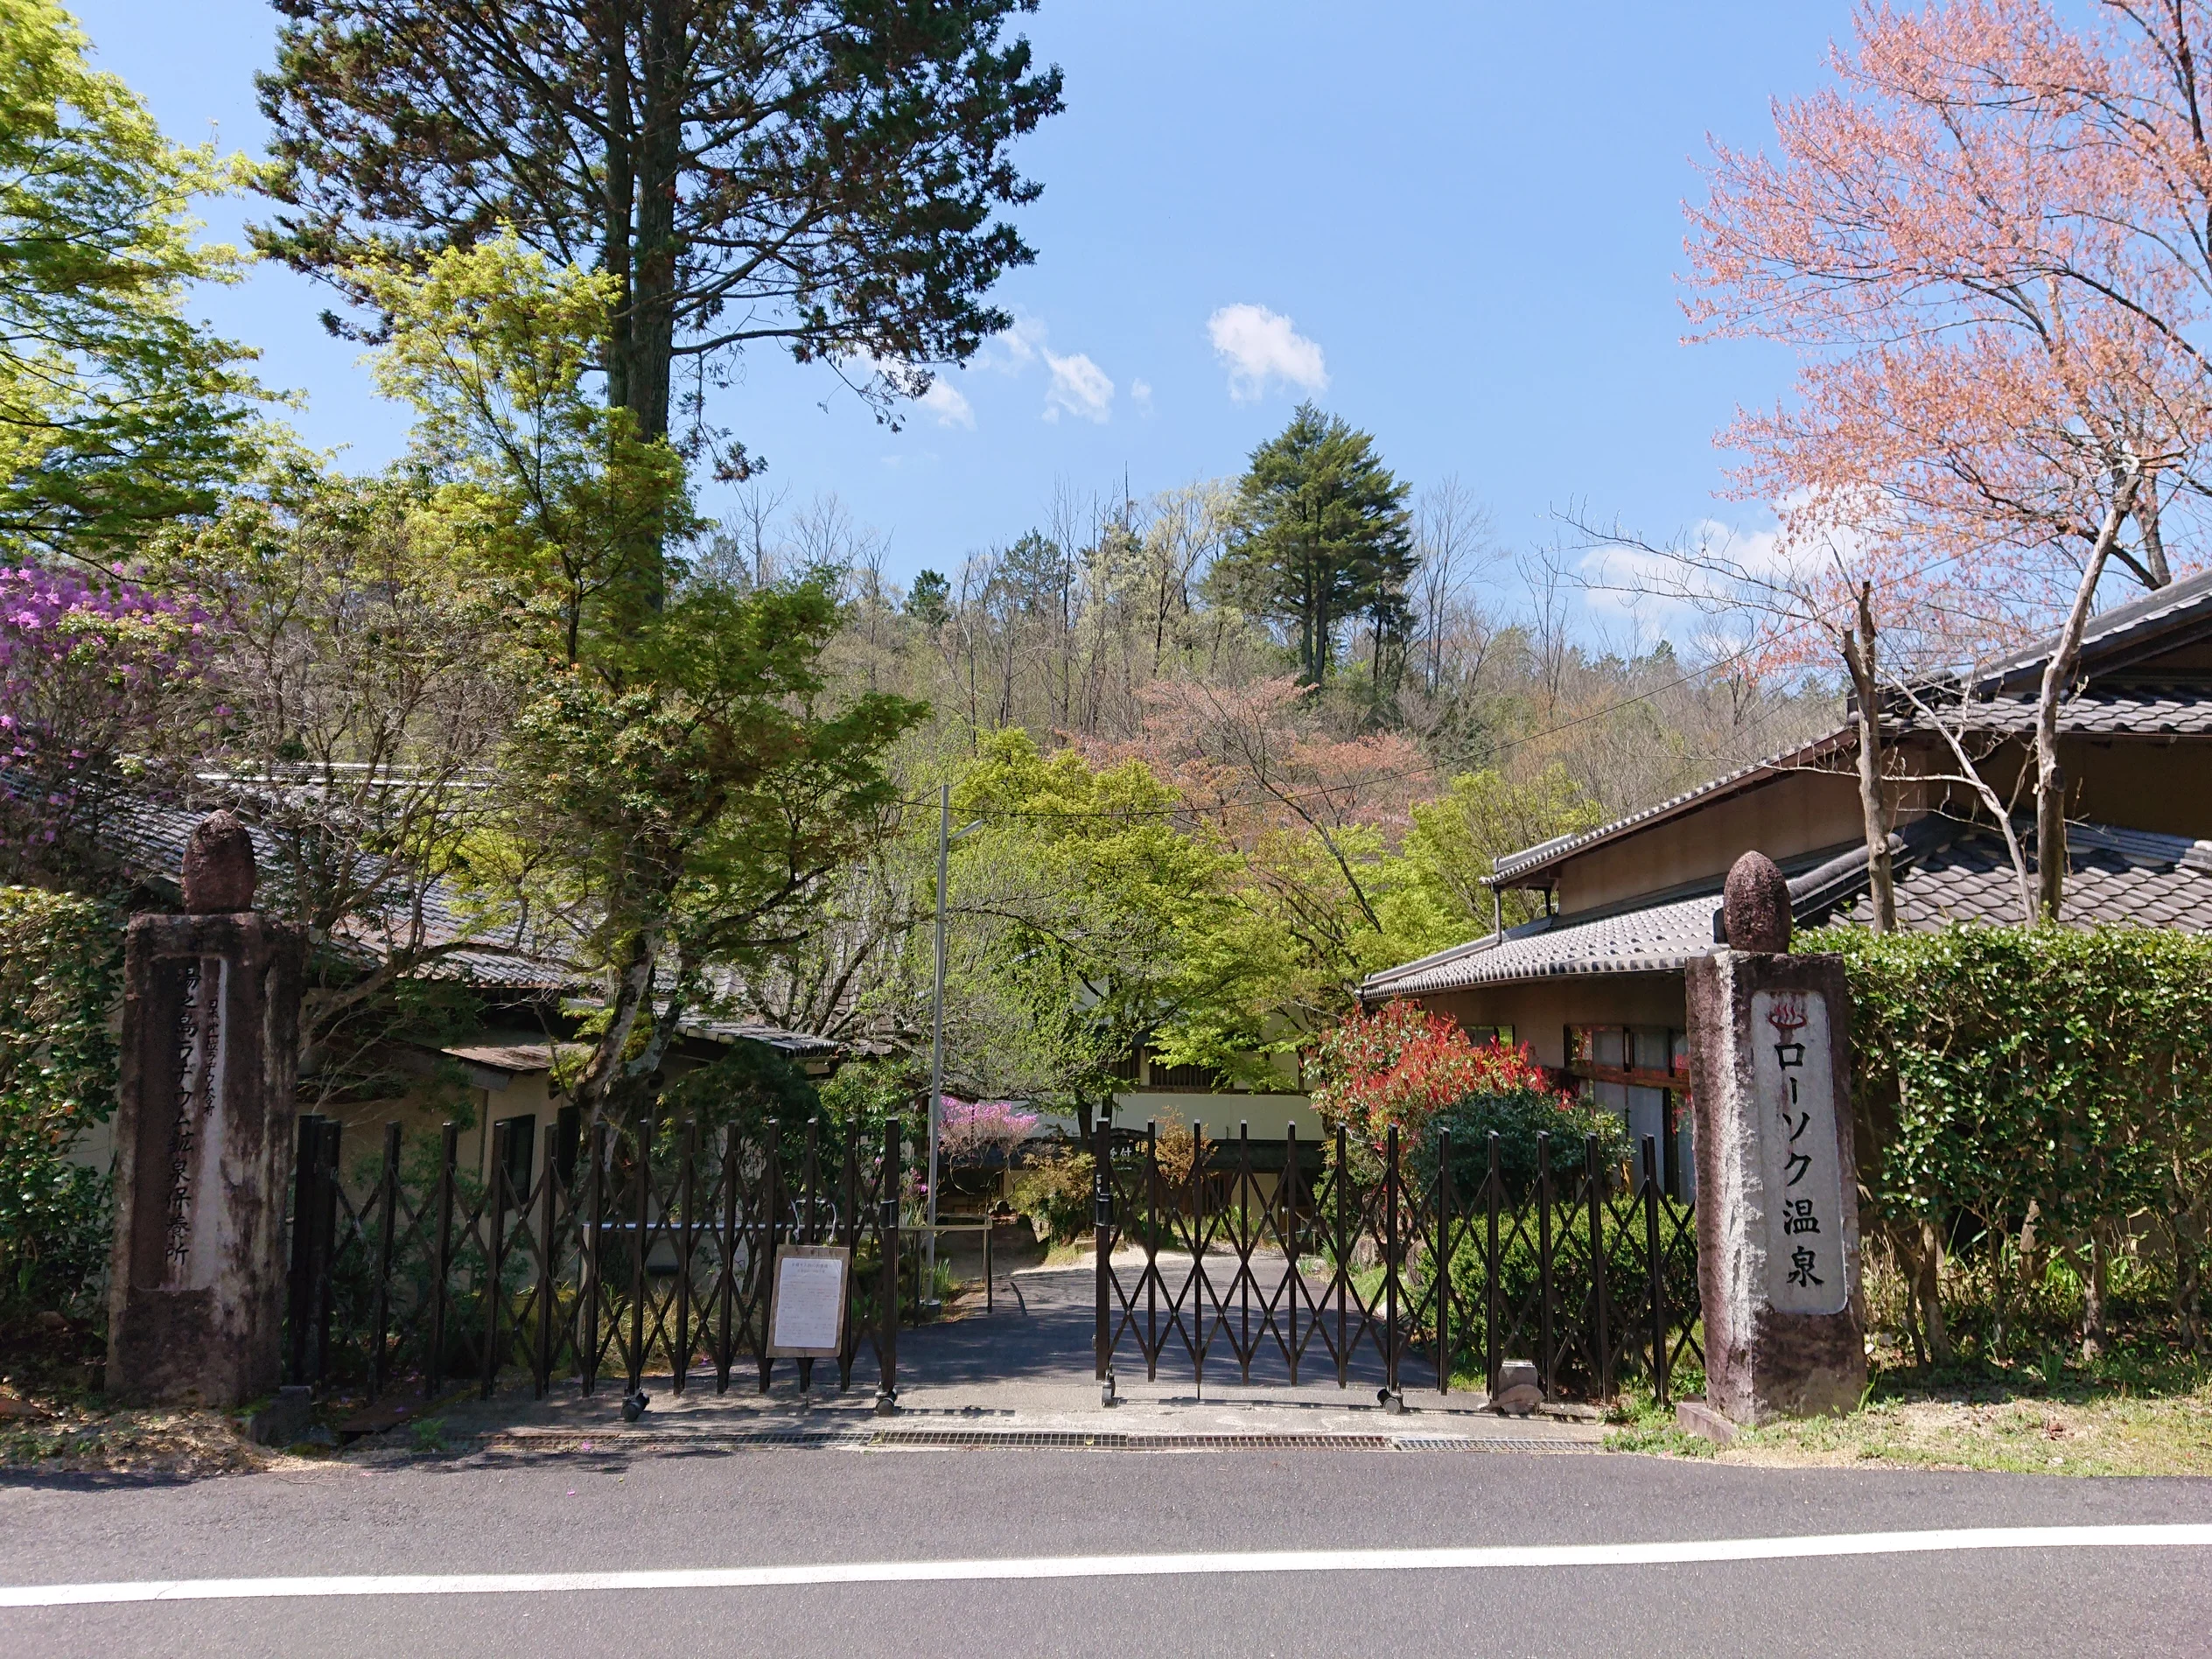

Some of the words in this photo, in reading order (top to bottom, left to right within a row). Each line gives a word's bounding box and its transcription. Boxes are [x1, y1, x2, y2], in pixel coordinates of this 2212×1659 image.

[1774, 1042, 1825, 1288] ローソク温泉
